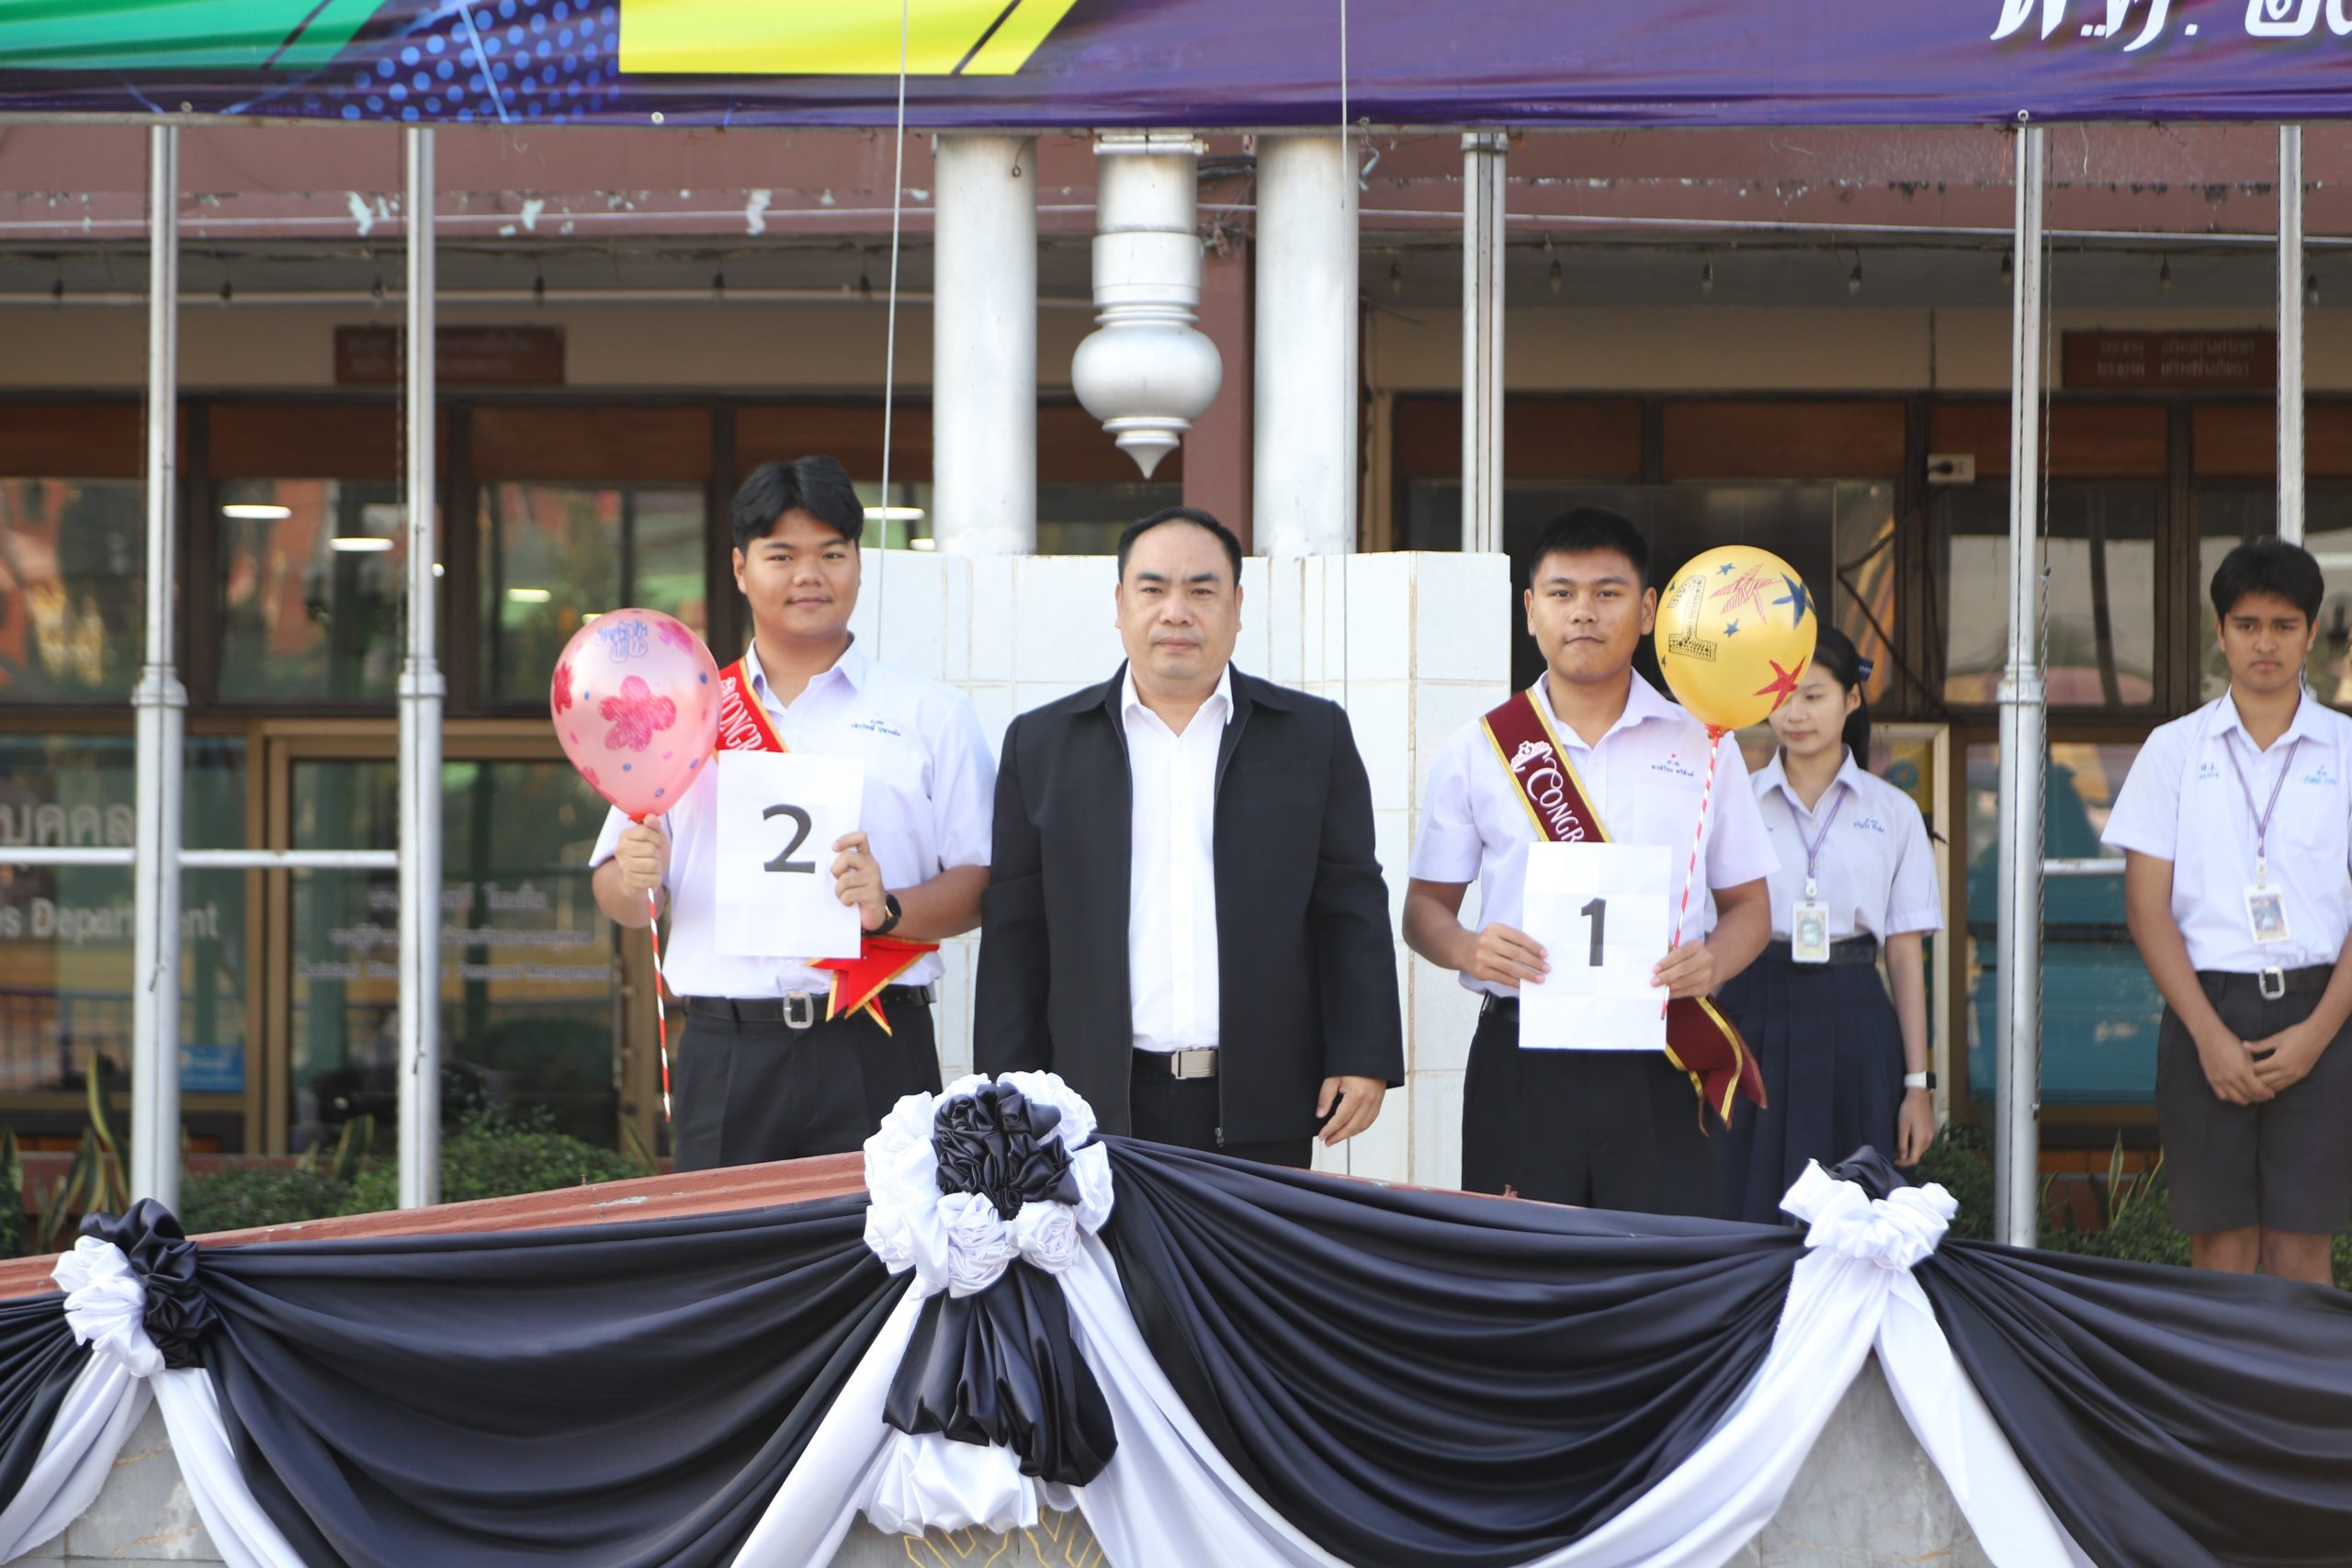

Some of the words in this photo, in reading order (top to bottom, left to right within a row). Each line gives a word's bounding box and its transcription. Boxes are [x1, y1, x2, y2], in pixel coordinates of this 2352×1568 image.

[719, 691, 768, 750] CONGR
[763, 803, 816, 874] 2
[30, 897, 220, 945] Deparnt
[1580, 897, 1606, 966] 1
